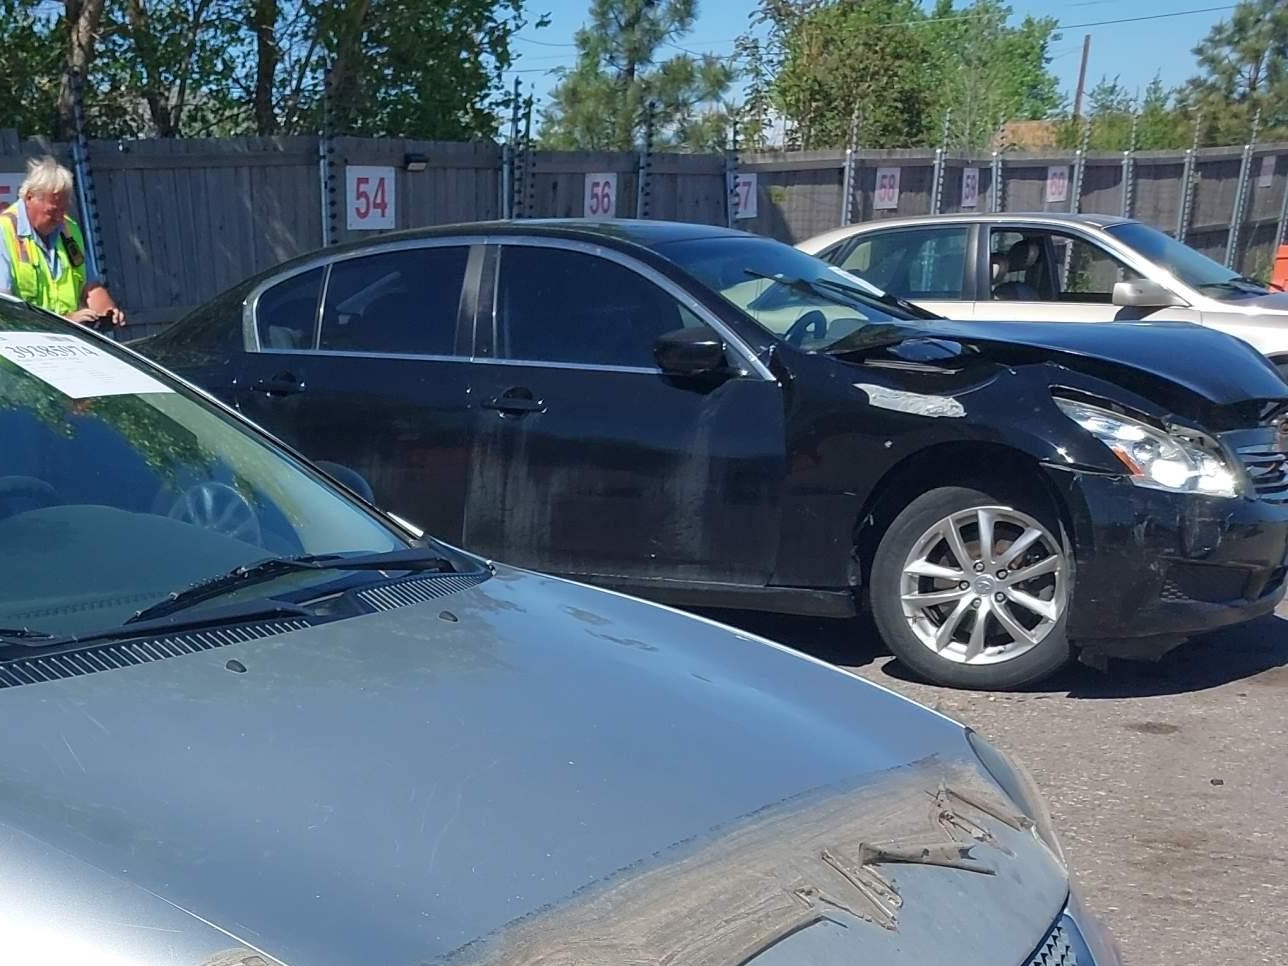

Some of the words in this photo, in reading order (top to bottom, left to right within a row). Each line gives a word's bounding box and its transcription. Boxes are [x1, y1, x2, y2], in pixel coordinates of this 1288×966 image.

[354, 176, 388, 220] 54
[589, 180, 612, 215] 56
[4, 345, 99, 359] 39385974
